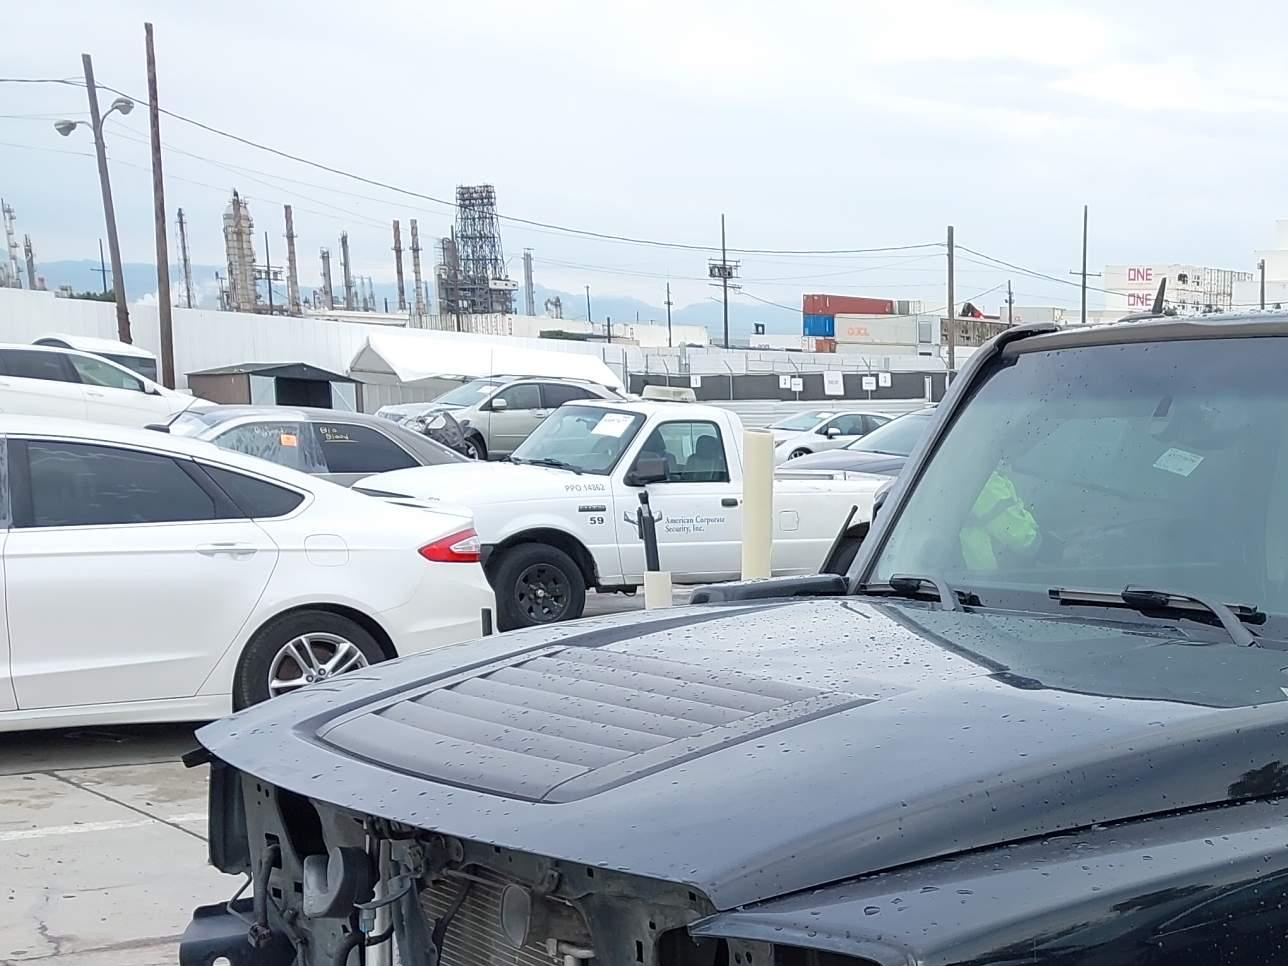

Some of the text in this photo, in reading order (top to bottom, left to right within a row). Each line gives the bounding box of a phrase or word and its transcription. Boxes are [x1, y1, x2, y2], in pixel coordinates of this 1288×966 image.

[1127, 267, 1153, 282] ONE
[1127, 292, 1153, 307] ONE
[589, 516, 605, 525] 59
[665, 515, 726, 526] American Corporate
